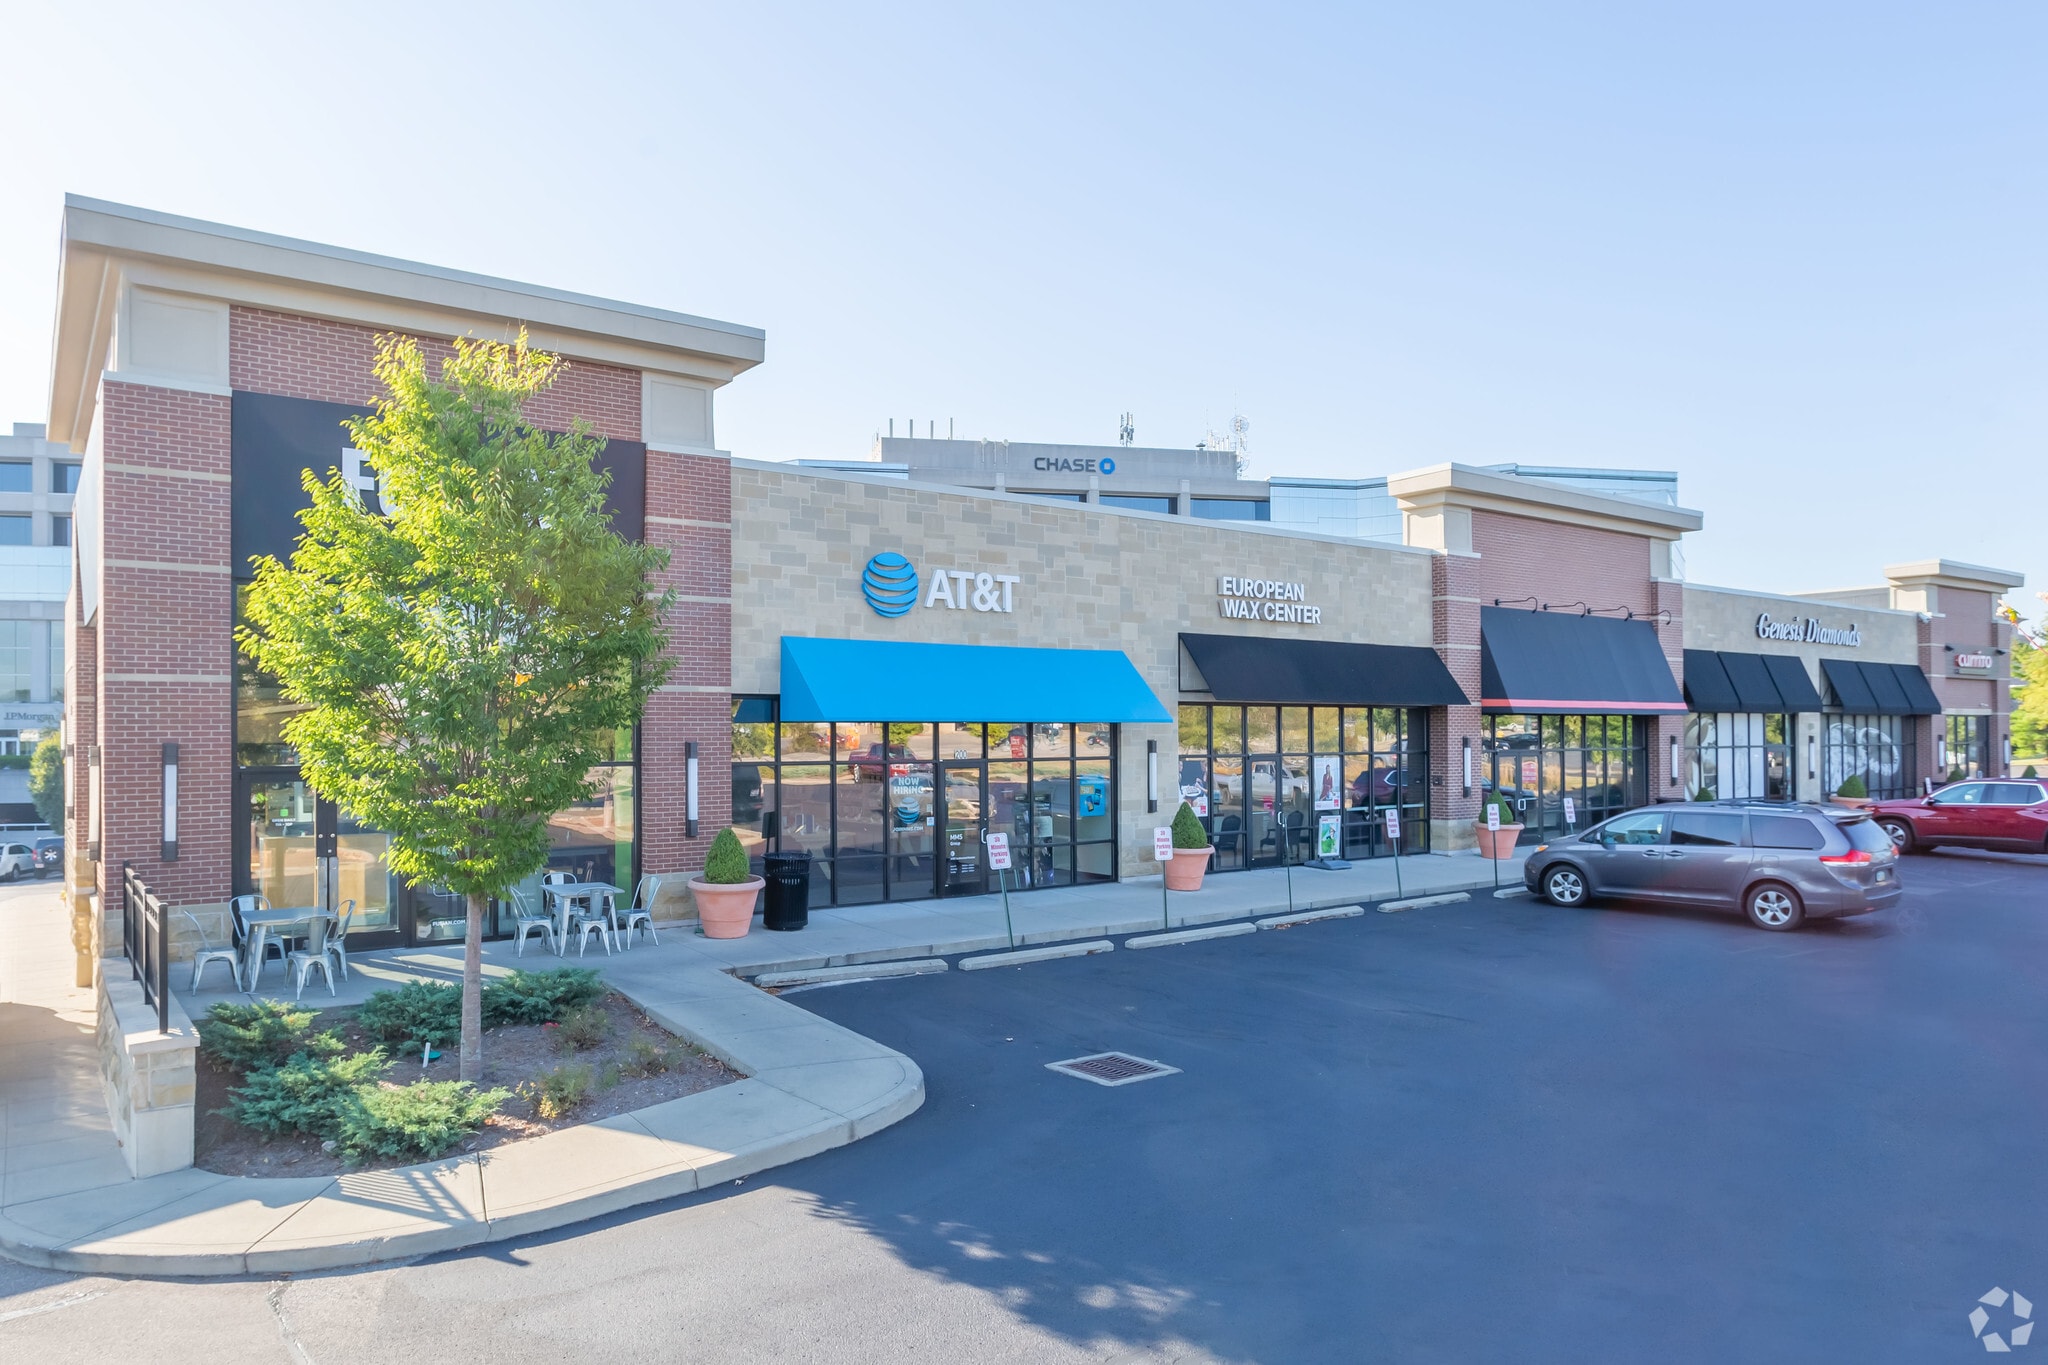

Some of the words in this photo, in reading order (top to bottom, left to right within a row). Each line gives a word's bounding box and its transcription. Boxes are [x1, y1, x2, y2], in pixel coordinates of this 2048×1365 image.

[1034, 457, 1096, 473] CHASE
[923, 569, 1021, 613] AT&T
[1218, 576, 1305, 602] EUROPEAN
[1219, 599, 1260, 620] WAX
[1263, 602, 1321, 624] CENTER
[1757, 613, 1805, 642] Genesis
[1805, 618, 1861, 647] Diamonds
[893, 786, 925, 795] HIRING
[898, 777, 920, 786] NOW
